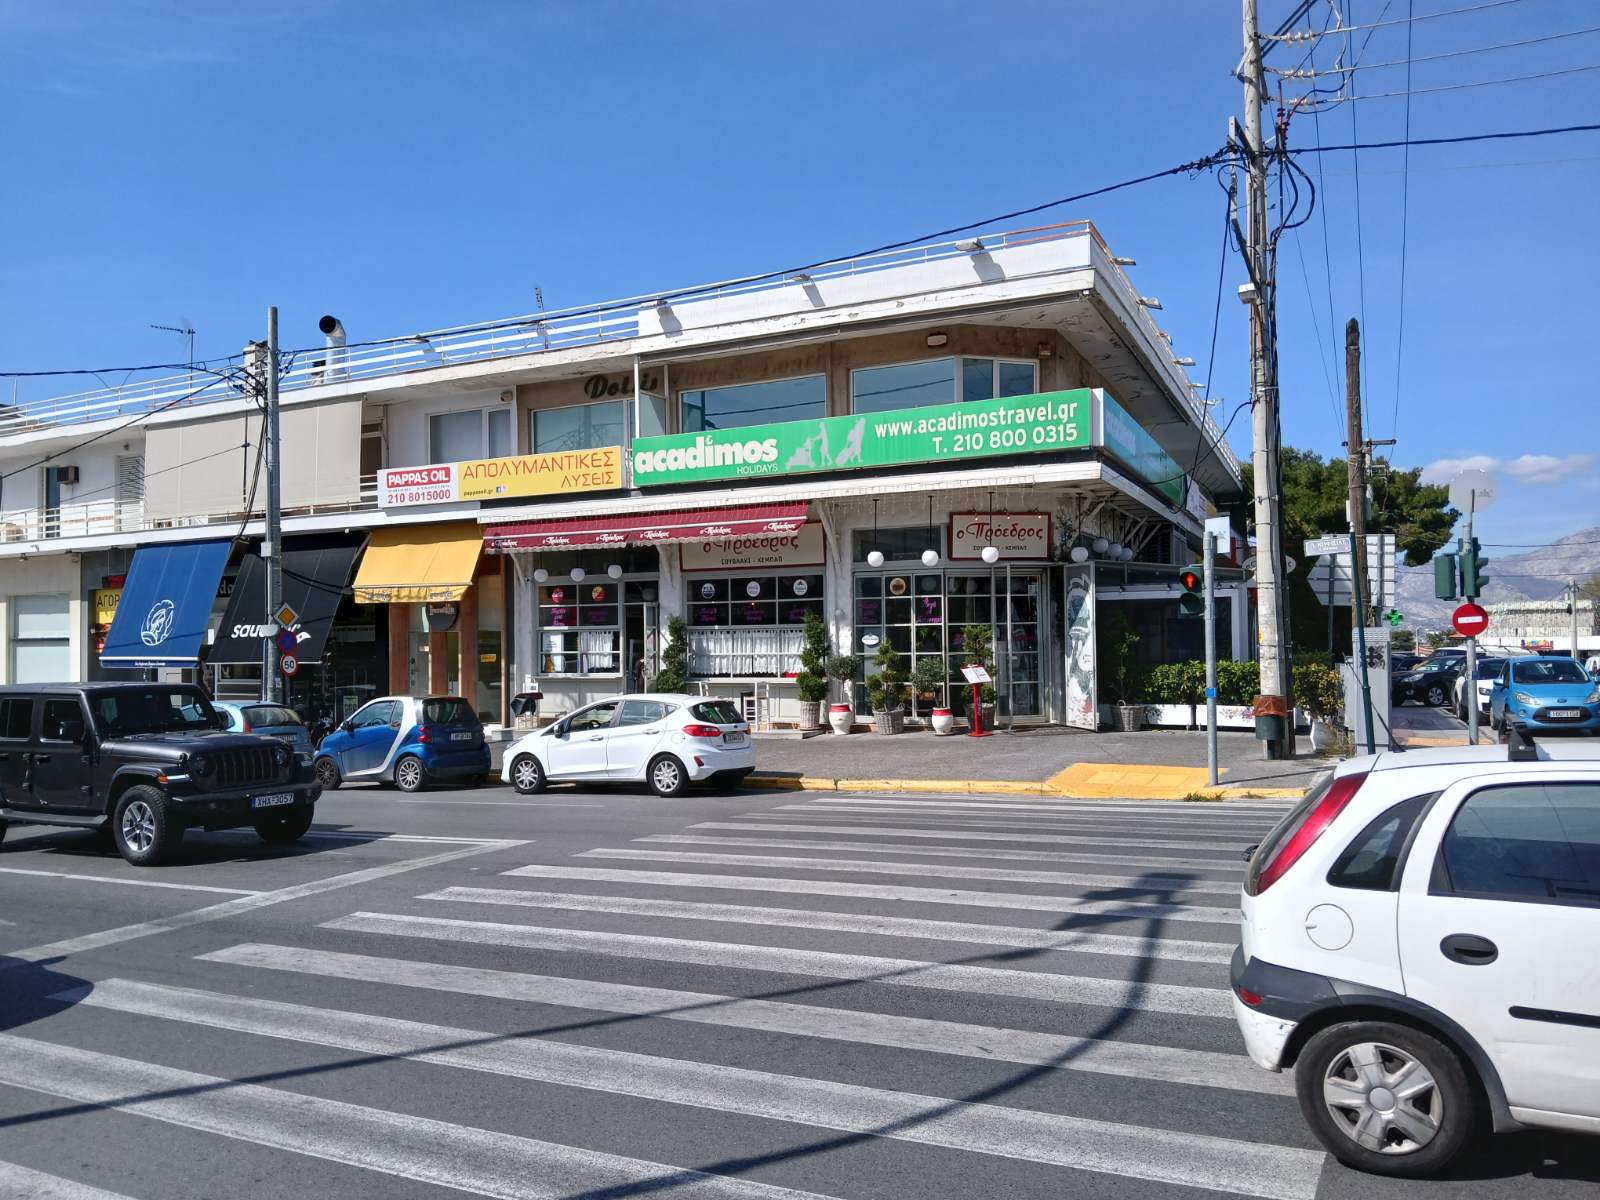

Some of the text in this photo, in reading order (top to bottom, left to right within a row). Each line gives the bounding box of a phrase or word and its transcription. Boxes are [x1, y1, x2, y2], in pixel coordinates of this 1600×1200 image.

[875, 402, 1078, 438] www.acadimostravel.gr
[932, 423, 1078, 453] T. 210 800 0315
[635, 435, 778, 473] acadimos
[463, 451, 614, 480] ΑΠΟΛΥΜΑΝΤΙΚΕΣ
[736, 463, 778, 475] HOLIDAYS
[388, 469, 449, 486] PAPPAS OIL
[561, 471, 615, 489] ΛΥΣΕΙΣ
[388, 489, 451, 504] 210 8015000
[957, 522, 1043, 541] ο Πρόεδρος
[703, 541, 712, 553] ο
[284, 660, 294, 669] 50
